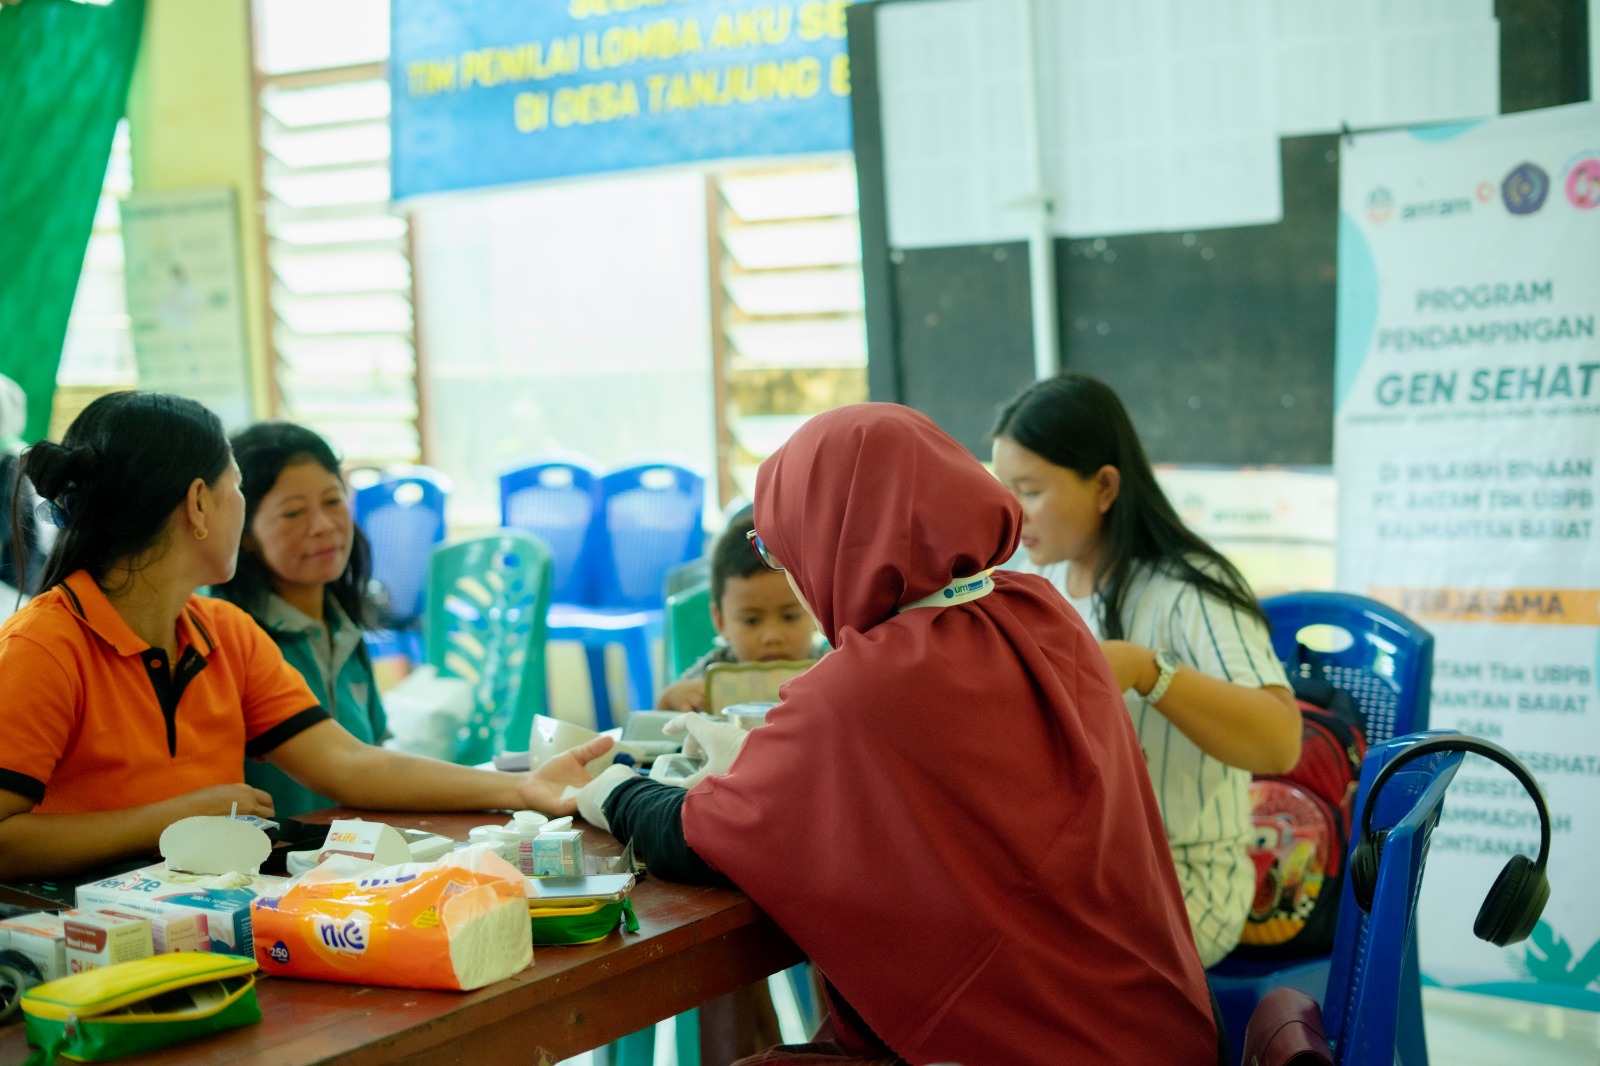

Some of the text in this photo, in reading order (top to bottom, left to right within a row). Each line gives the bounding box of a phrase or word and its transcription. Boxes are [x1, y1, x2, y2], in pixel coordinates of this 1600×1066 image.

[408, 62, 454, 94] TIM
[461, 36, 579, 88] PENILAI
[584, 20, 701, 69] LOMBA
[711, 6, 790, 49] AKU
[514, 92, 548, 132] DI
[552, 83, 639, 126] DESA
[647, 61, 820, 113] TANJUNG
[1415, 280, 1553, 312] PROGRAM
[1377, 315, 1594, 352] PENDAMPINGAN
[1375, 362, 1600, 406] GEN SEHAT
[1519, 519, 1593, 540] BARAT
[1434, 660, 1482, 680] TAM
[1432, 690, 1588, 713] ANTAN BARAT
[1518, 751, 1600, 775] ESEHAT
[1450, 777, 1547, 798] VERSITAS
[1442, 806, 1572, 832] AMMADIYAH
[1430, 834, 1541, 856] ONTIANAK
[270, 947, 288, 958] 250
